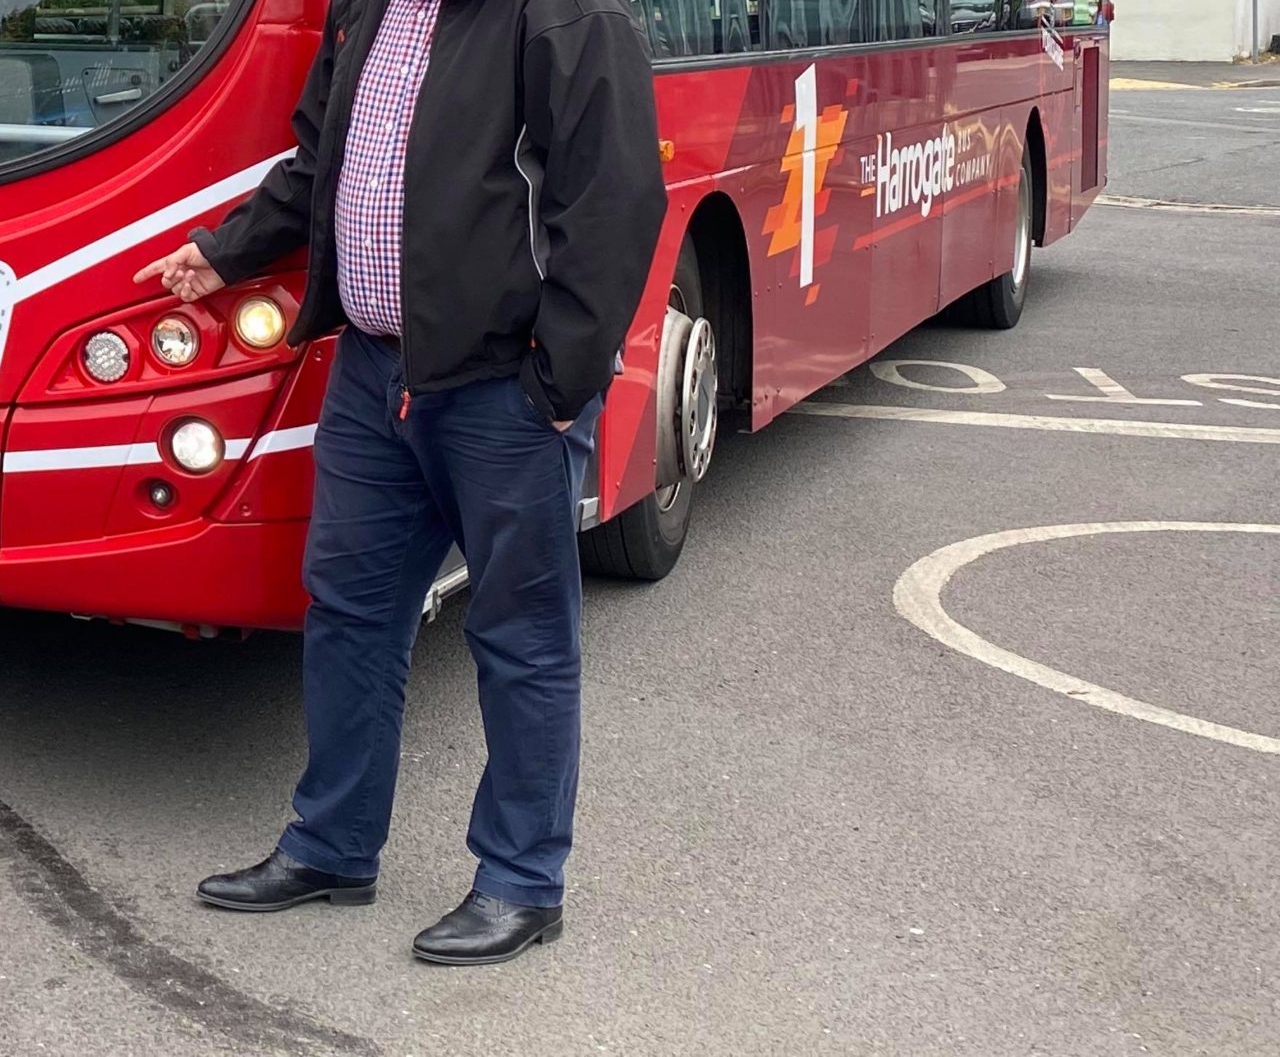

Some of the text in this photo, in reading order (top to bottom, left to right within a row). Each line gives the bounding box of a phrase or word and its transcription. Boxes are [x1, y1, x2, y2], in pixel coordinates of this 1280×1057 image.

[794, 63, 818, 288] 1
[860, 122, 955, 218] THE Harrogate
[955, 153, 991, 187] COMPANY
